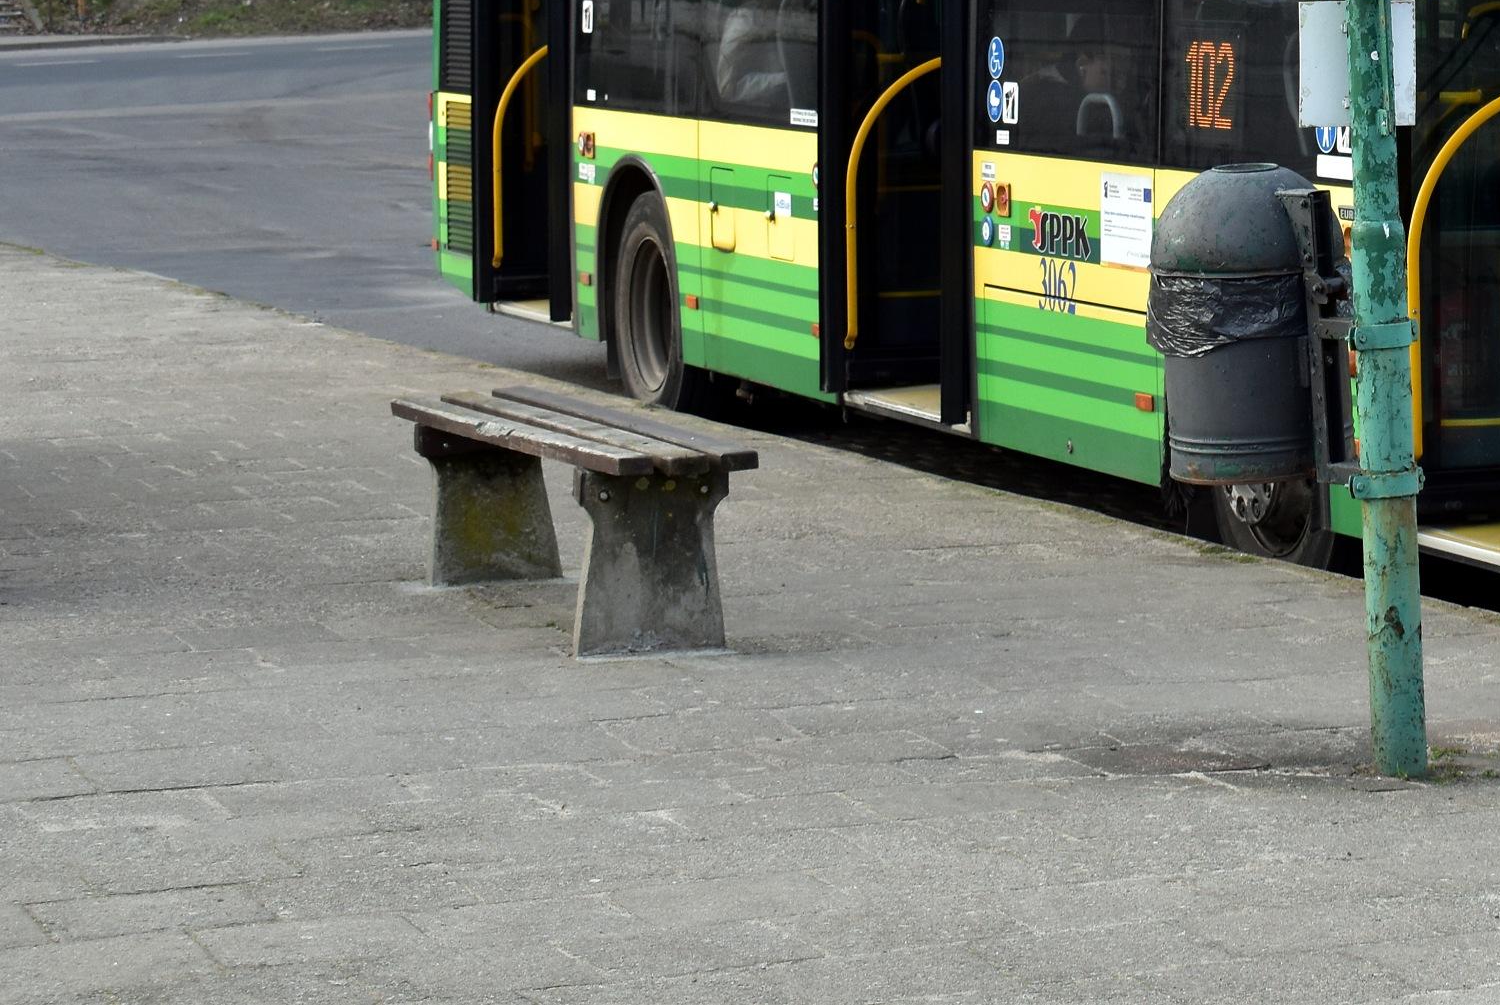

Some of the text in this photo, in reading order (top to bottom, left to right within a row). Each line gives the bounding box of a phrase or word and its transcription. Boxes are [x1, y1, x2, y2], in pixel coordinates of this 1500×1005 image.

[1186, 42, 1234, 130] 102
[1038, 212, 1091, 260] SPPK
[1038, 257, 1076, 315] 3062
